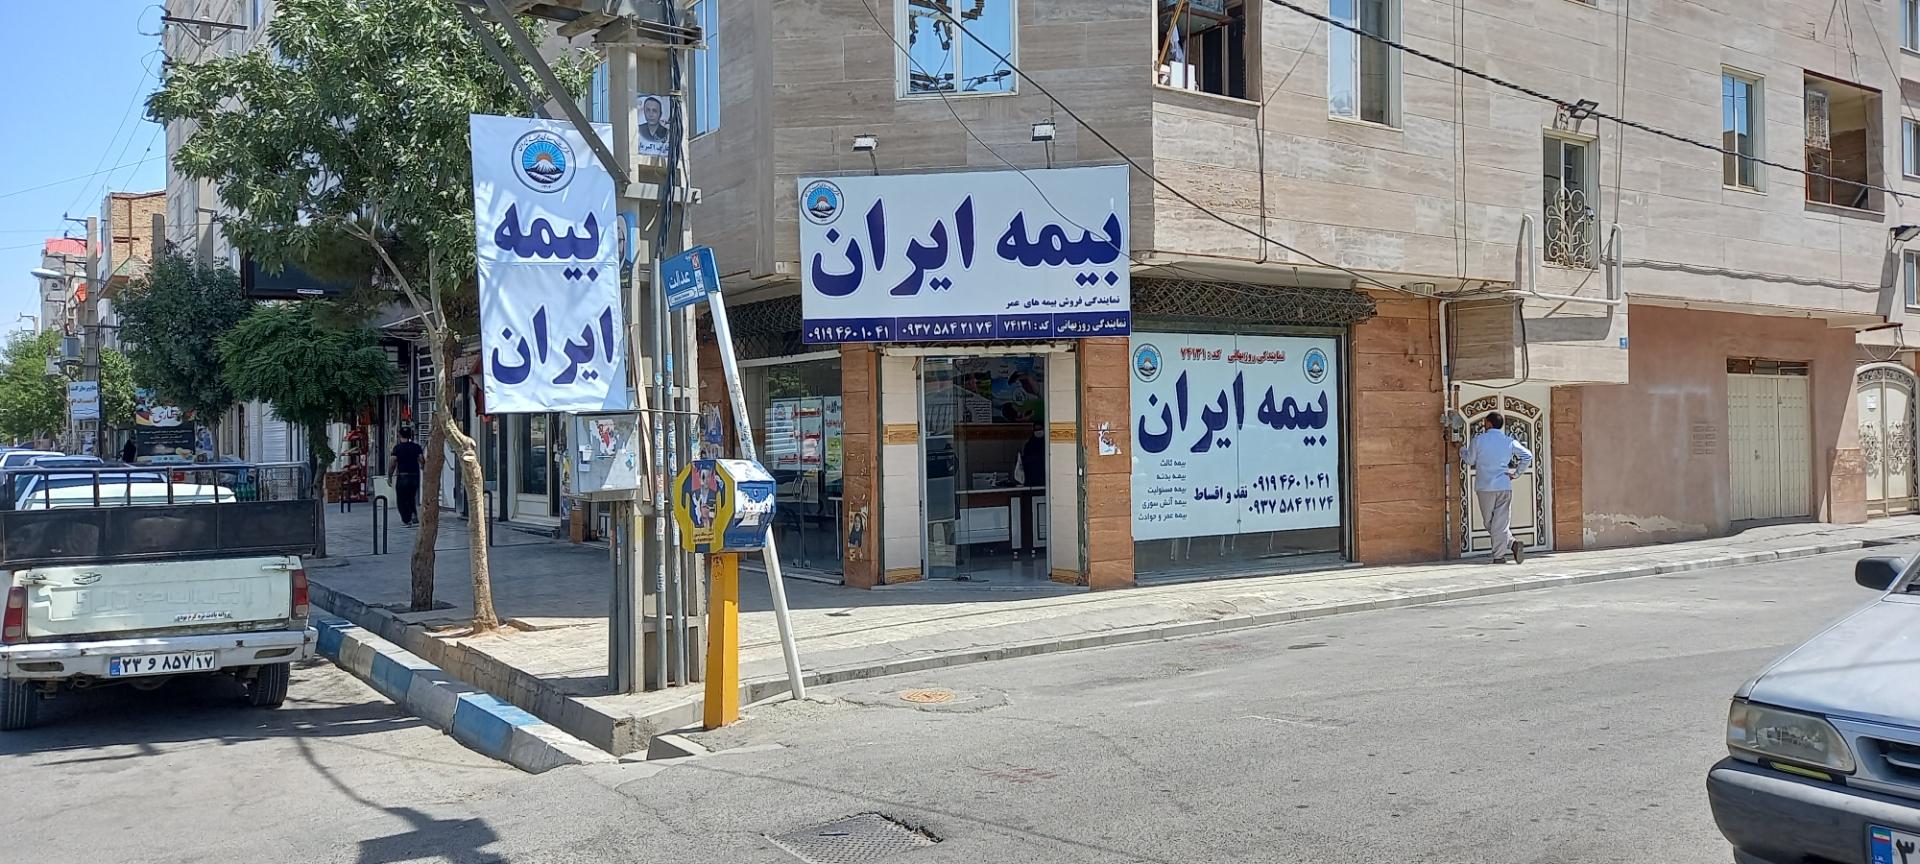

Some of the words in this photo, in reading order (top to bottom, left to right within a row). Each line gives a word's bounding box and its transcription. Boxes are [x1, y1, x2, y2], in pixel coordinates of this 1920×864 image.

[494, 202, 599, 282] بیمه
[812, 195, 974, 297] ایران
[997, 209, 1122, 286] بیمه
[669, 270, 691, 290] عدالت
[1006, 300, 1020, 310] عمر
[1024, 298, 1040, 309] های
[1042, 298, 1057, 307] بیمه
[1058, 297, 1083, 307] فروش
[1085, 296, 1121, 307] نمایندگی
[902, 324, 931, 336] ۰۹۳۷
[933, 322, 959, 336] ۵۸۴
[960, 322, 973, 335] ۲۱
[976, 322, 993, 335] ۷۴
[1003, 320, 1032, 331] ۷۴۱۳۱
[1057, 320, 1091, 333] روزبهانی
[1092, 317, 1127, 331] نمایندگی
[808, 326, 833, 340] ۰۹۱۹
[835, 326, 858, 340] ۴۶۰
[861, 326, 872, 339] ۱۰
[875, 325, 889, 339] ۴۱
[492, 305, 615, 385] ایران
[1139, 369, 1245, 453] ایران
[1258, 384, 1329, 447] بیمه
[1160, 459, 1172, 467] ثالث
[1174, 460, 1186, 468] بیمه
[1156, 473, 1171, 481] بدنه
[1172, 473, 1186, 481] بیمه
[1253, 475, 1277, 492] ۰۹۱۹
[1280, 474, 1300, 490] ۴۶۰
[1304, 474, 1314, 489] ۱۰
[1317, 472, 1329, 489] ۴۱
[1193, 486, 1223, 501] اقساط
[1225, 491, 1231, 504] و
[1233, 485, 1248, 499] نقد
[1248, 499, 1276, 515] ۰۹۳۷
[1280, 497, 1302, 513] ۵۸۴
[1304, 497, 1316, 511] ۲۱
[1319, 495, 1333, 511] ۷۴
[1138, 513, 1156, 521] حوادث
[122, 658, 142, 673] ۲۳
[147, 657, 156, 671] و
[162, 655, 192, 671] ۸۵۷
[196, 655, 213, 669] ۱۷
